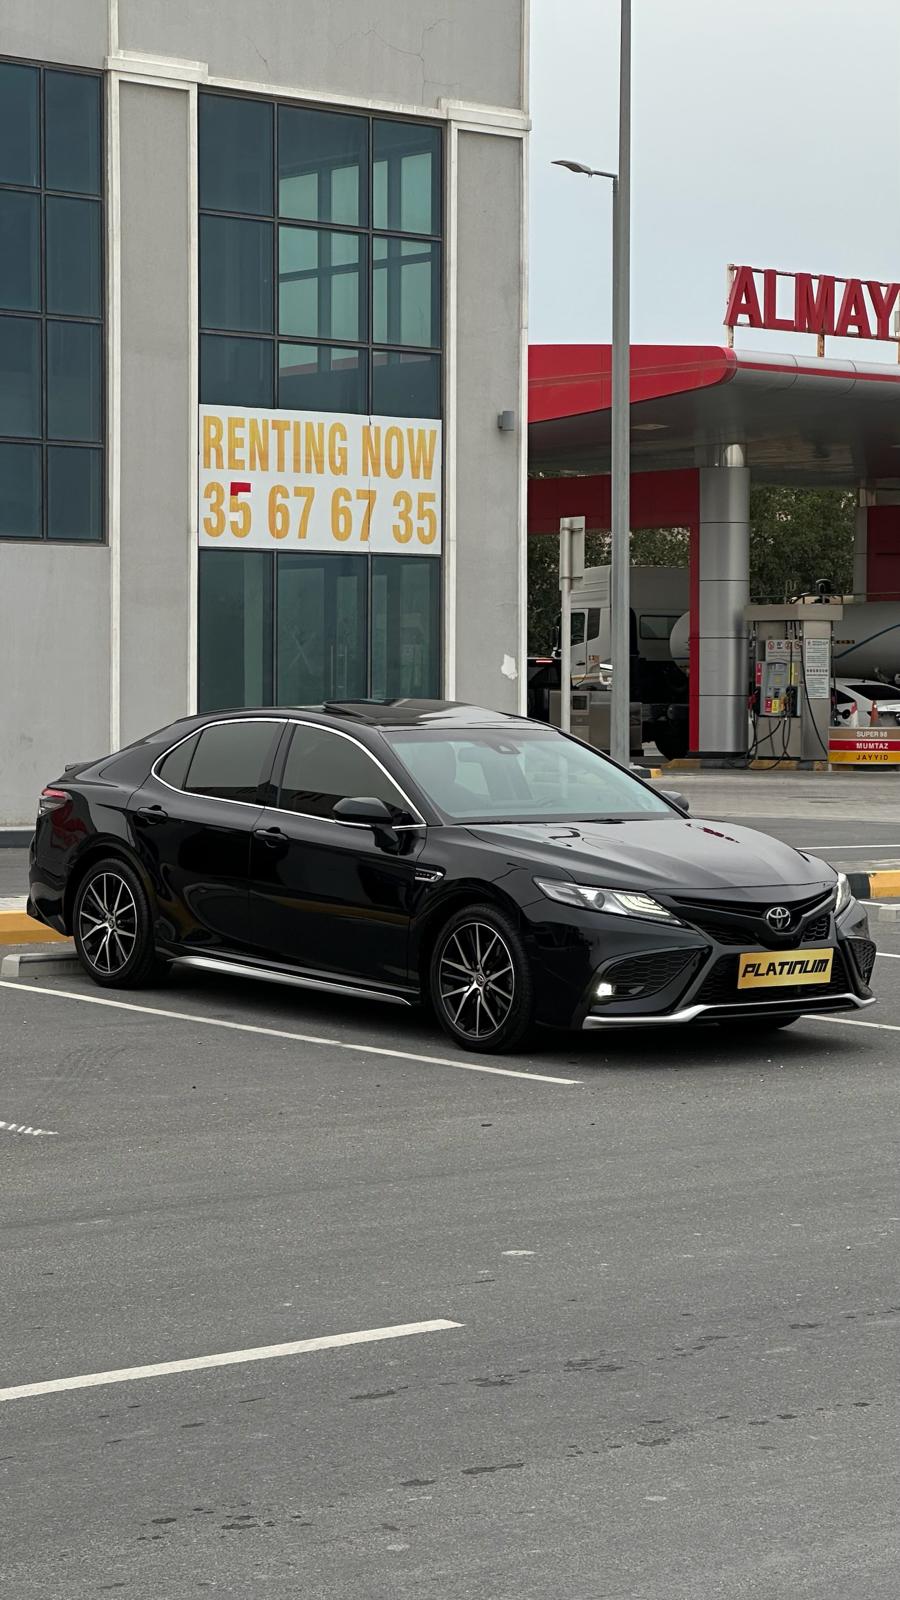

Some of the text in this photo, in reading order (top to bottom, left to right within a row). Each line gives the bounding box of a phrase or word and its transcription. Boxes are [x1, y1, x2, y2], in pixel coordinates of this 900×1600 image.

[203, 415, 437, 480] RENTING NOW
[203, 481, 437, 545] 35 67 67 35
[856, 742, 889, 750] MUMTAZ
[742, 959, 830, 978] PLATINUM
